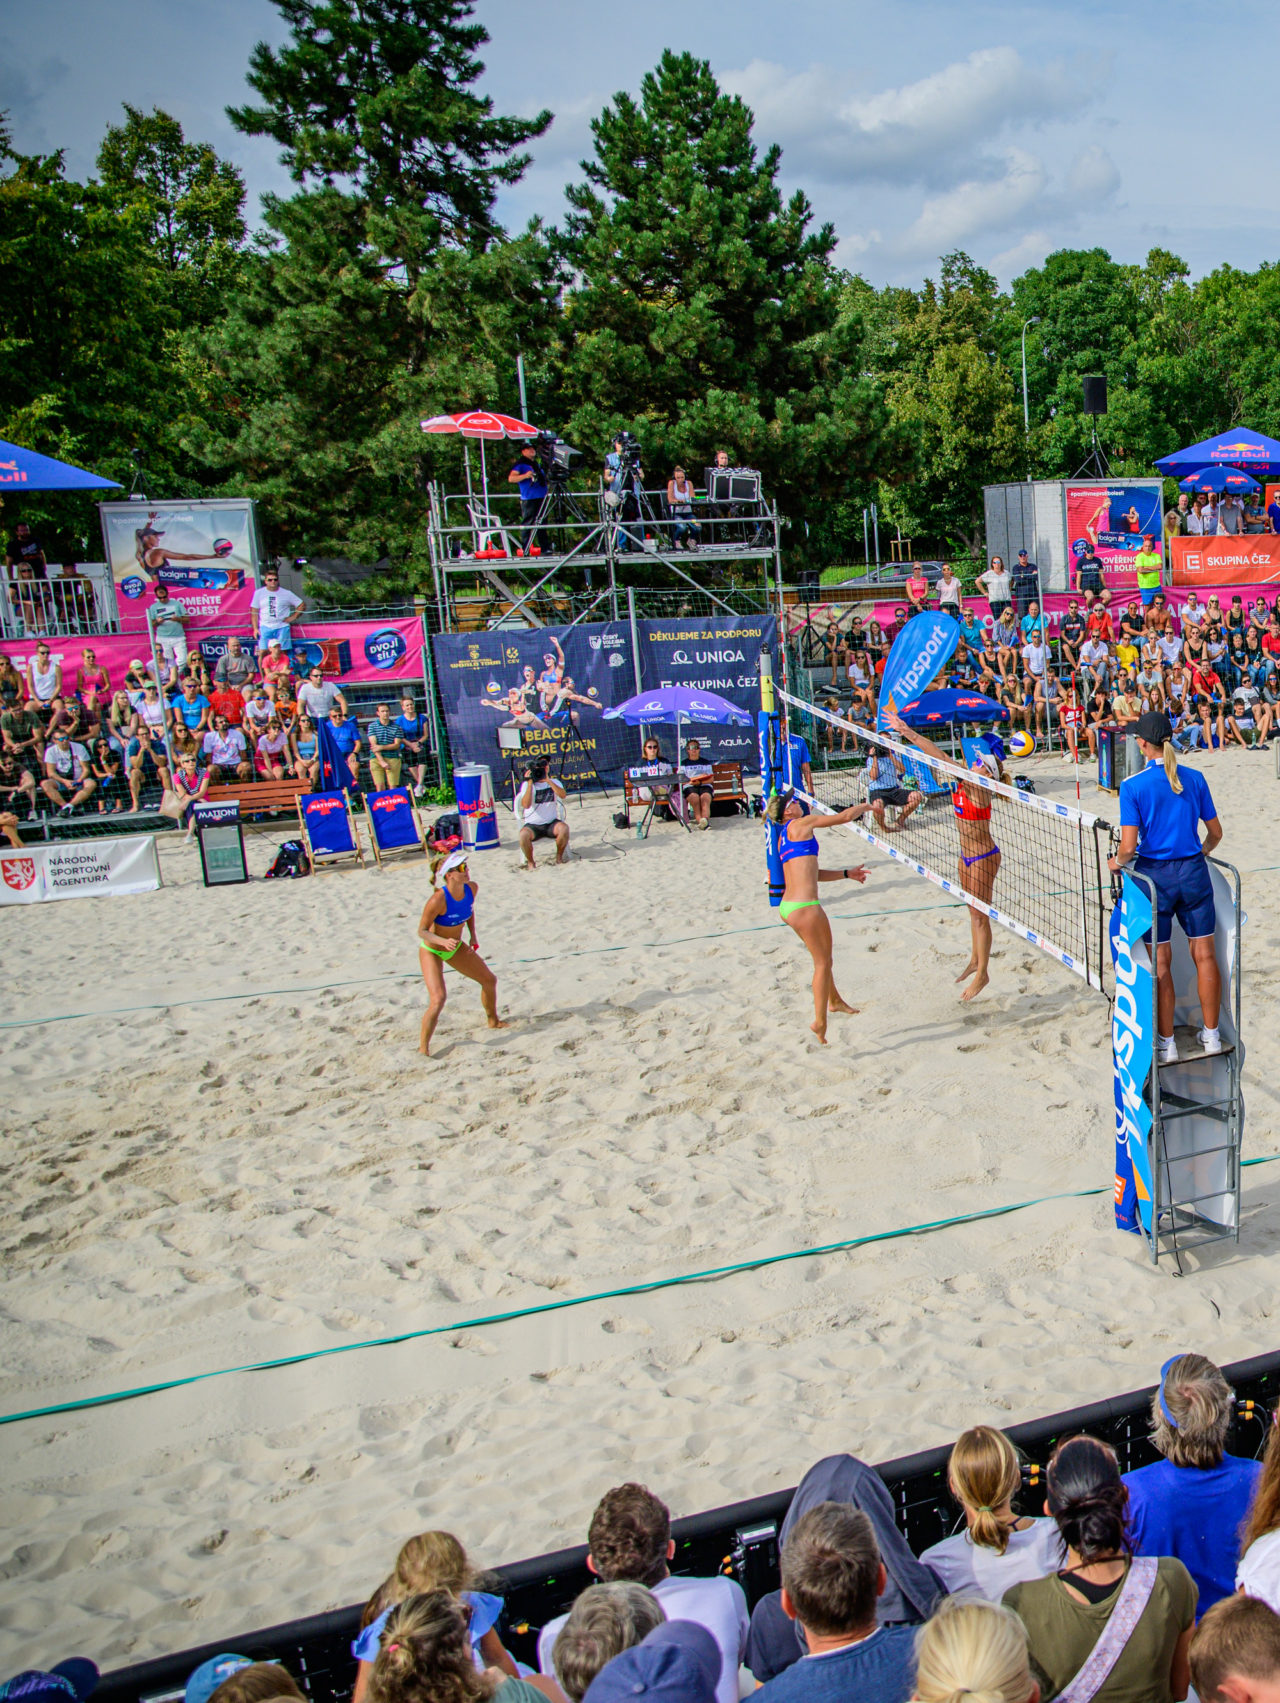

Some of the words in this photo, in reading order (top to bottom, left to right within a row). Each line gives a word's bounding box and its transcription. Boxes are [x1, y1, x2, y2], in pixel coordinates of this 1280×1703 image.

[1208, 555, 1250, 566] SKUPINA
[1252, 553, 1271, 564] ČEZ
[158, 569, 187, 580] Ibalgin
[185, 605, 219, 615] OLEST
[649, 631, 699, 641] DĚKUJEME
[702, 631, 713, 640] ZA
[716, 629, 761, 639] PODPORU
[202, 643, 250, 656] Ibaln
[369, 638, 398, 654] DVOJÍ
[377, 650, 397, 660] SÍLA
[696, 650, 745, 663] UNIQA
[893, 625, 948, 698] Tipsport
[682, 679, 734, 690] SKUPINA
[737, 676, 758, 687] ČEZ
[525, 727, 571, 741] BEACH
[502, 743, 557, 758] PRAGUE
[560, 739, 596, 752] OPEN
[649, 768, 657, 776] 12
[311, 801, 339, 809] MATTONI
[377, 798, 404, 806] MATTONI
[459, 800, 477, 810] Red
[199, 808, 237, 819] MATTONI
[50, 853, 97, 866] NÁRODNÍ
[50, 863, 110, 877] SPORTOVNÍ
[52, 874, 109, 887] AGENTURA
